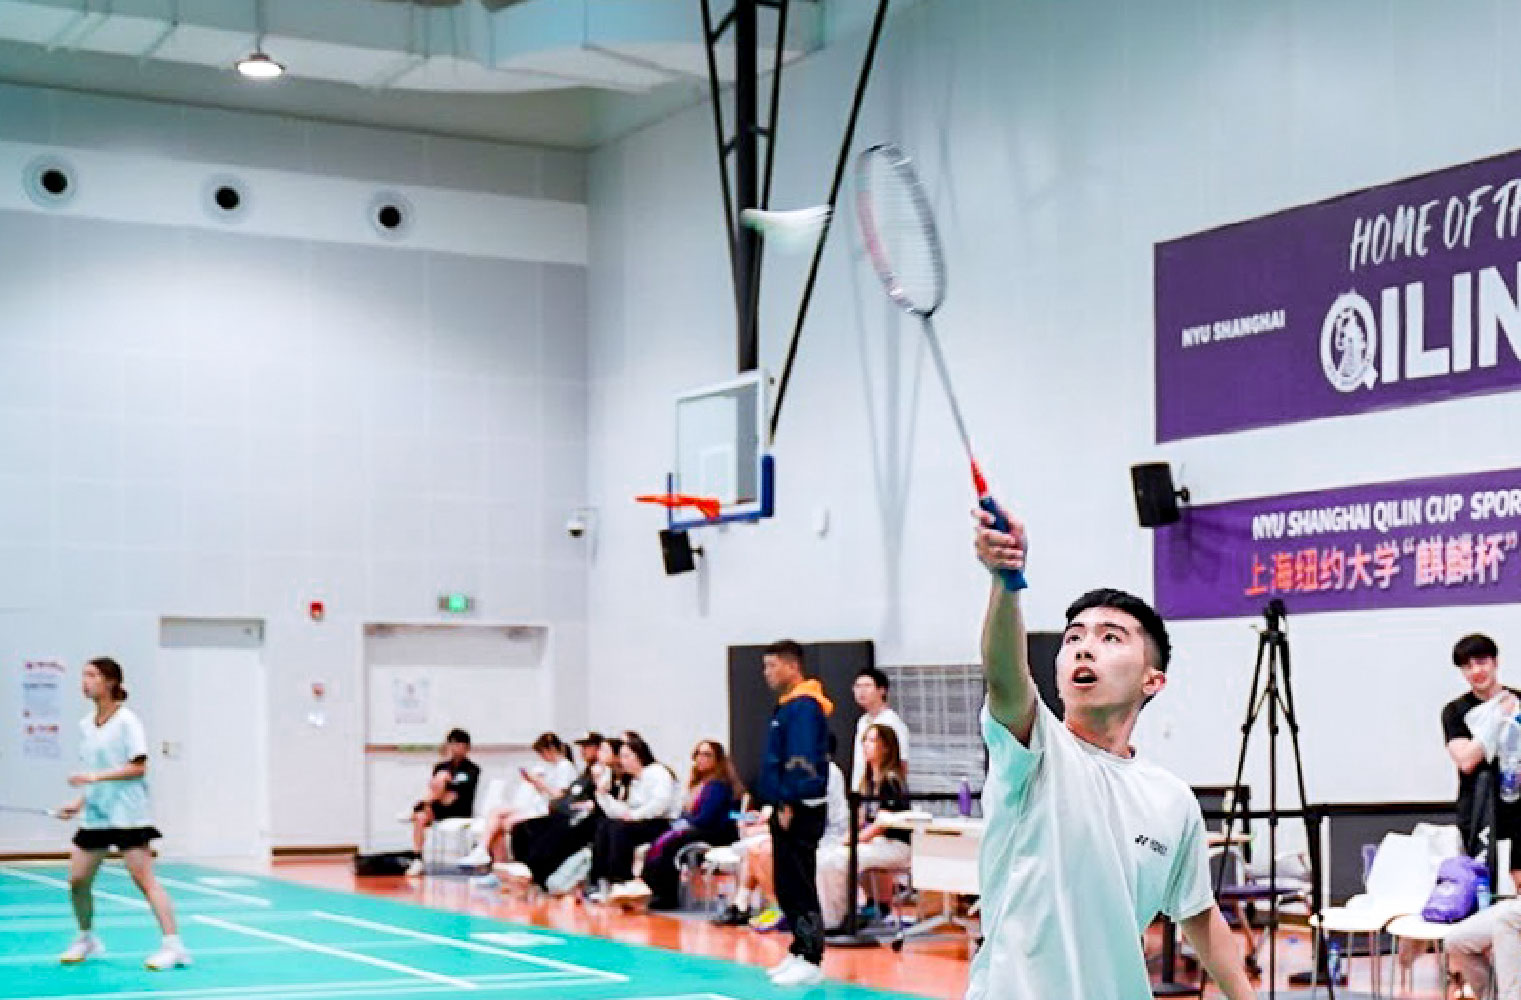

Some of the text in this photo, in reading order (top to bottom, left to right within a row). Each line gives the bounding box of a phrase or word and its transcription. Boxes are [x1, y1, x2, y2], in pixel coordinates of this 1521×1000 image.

[1350, 199, 1440, 273] HOME
[1442, 184, 1493, 250] OF
[1181, 308, 1286, 349] NYU SHANGHAI
[1252, 511, 1286, 541] NYU
[1286, 502, 1371, 538] SHANGHAI
[1373, 497, 1423, 533] QILIN
[1425, 493, 1464, 524] CUP
